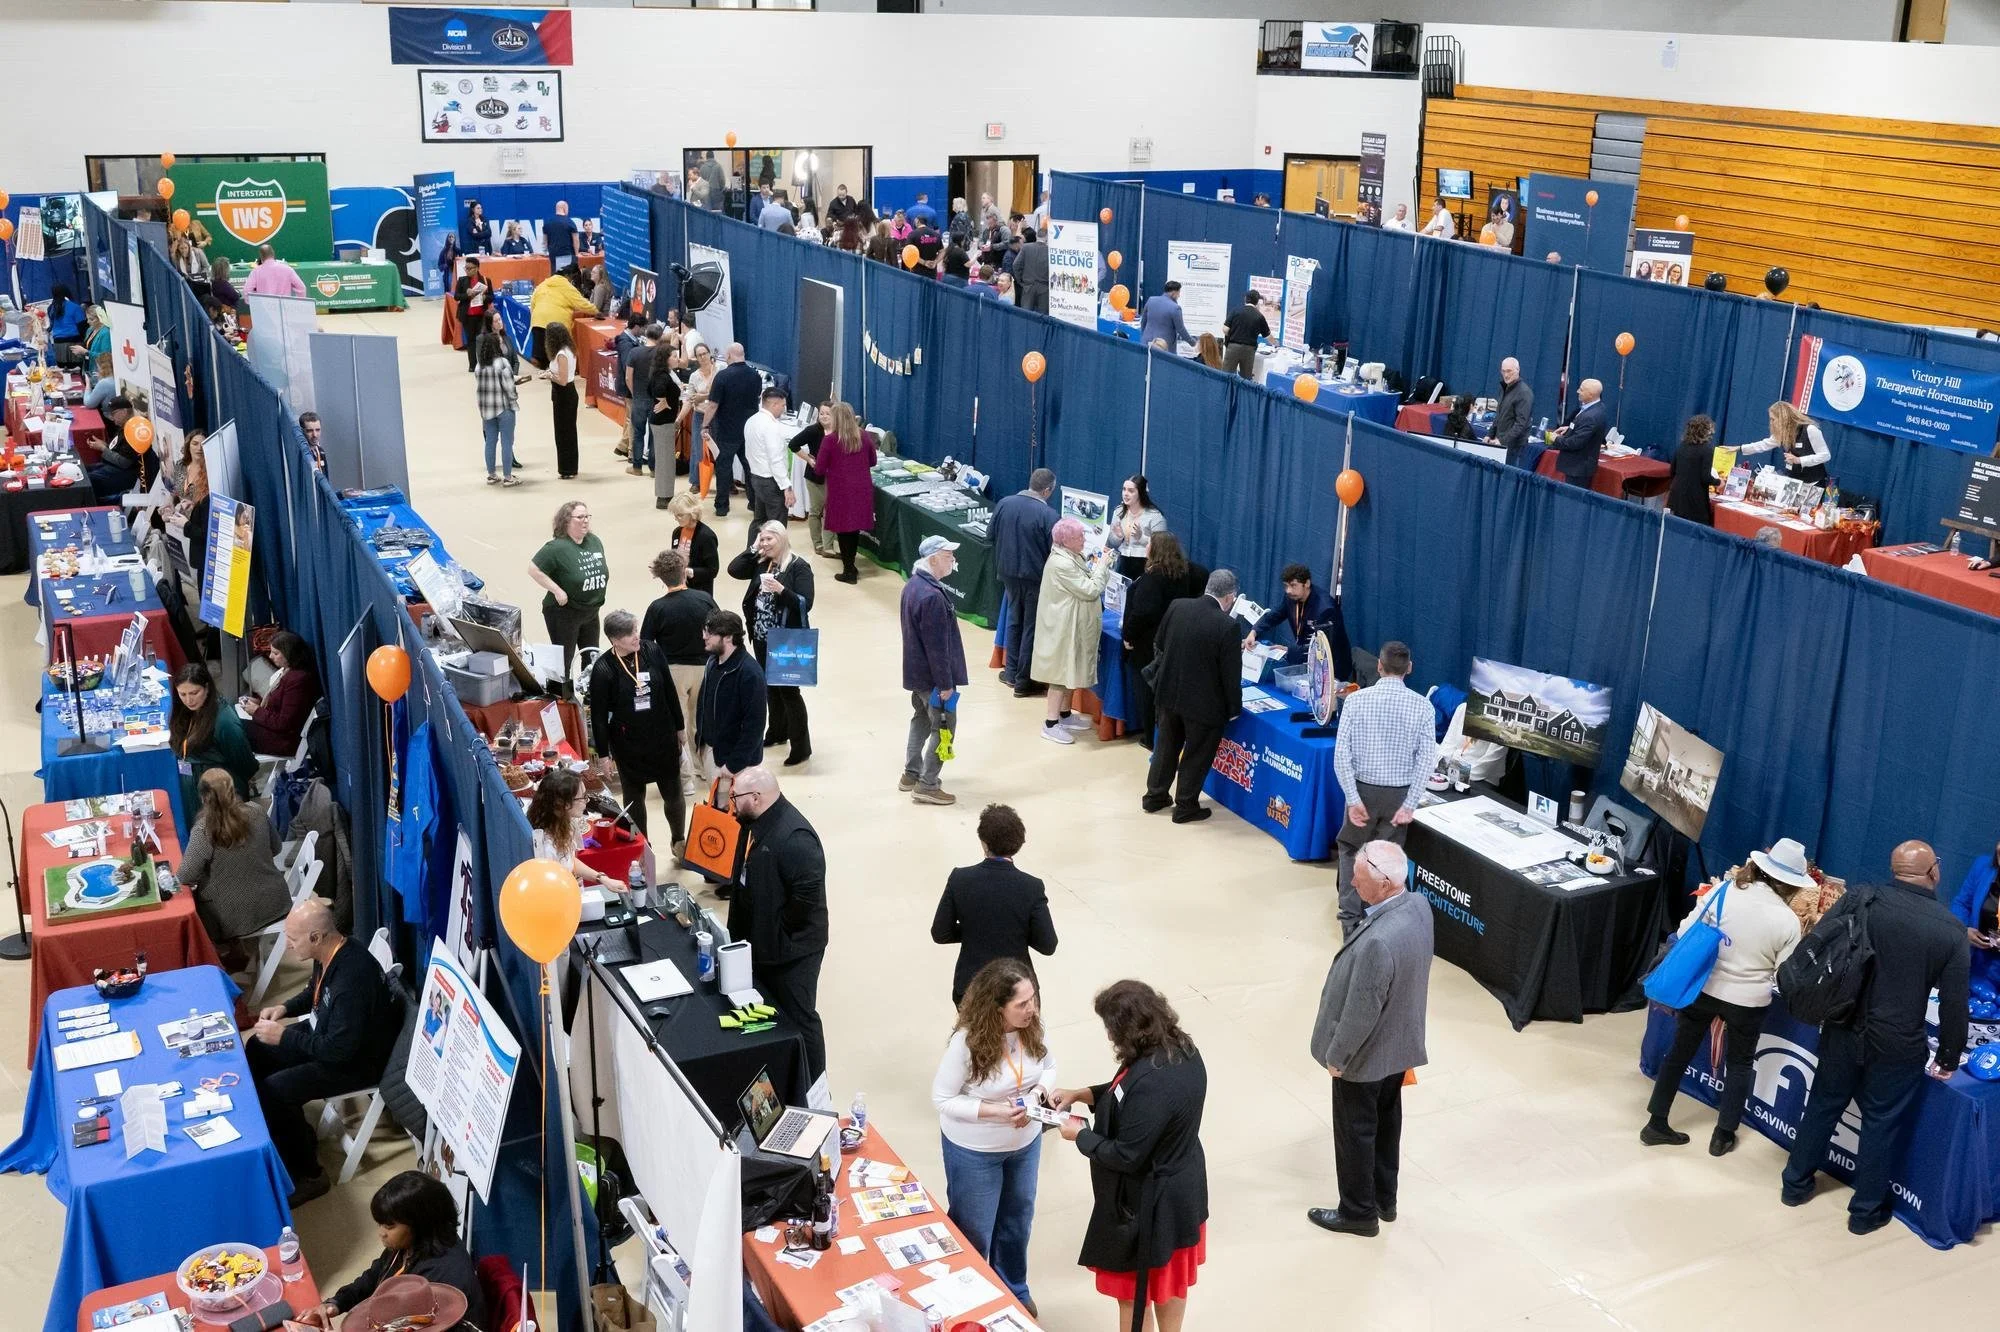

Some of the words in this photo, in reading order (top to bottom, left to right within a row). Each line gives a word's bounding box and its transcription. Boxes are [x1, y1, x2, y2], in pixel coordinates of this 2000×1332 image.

[1306, 47, 1353, 58] KNIGHTS
[227, 189, 273, 198] INTERSTATE
[232, 206, 273, 230] IWS
[1536, 206, 1555, 215] Business
[1555, 210, 1574, 218] solutions
[1050, 254, 1093, 269] BELONG
[1059, 248, 1079, 256] WHERE
[1073, 305, 1090, 313] More.
[1912, 369, 1943, 385] Victory
[1944, 376, 1961, 389] Hill
[1876, 377, 1925, 397] Therapeutic
[1927, 385, 1994, 413] Horsemanship
[1891, 398, 1907, 408] Finding
[1908, 402, 1918, 411] Hope
[1923, 404, 1939, 415] Healing
[1939, 408, 1957, 419] through
[1906, 415, 1921, 426] (845)
[1921, 416, 1951, 431] 843-0020
[582, 574, 606, 591] CATS
[1217, 746, 1247, 772] CAR
[1262, 754, 1303, 782] LAUNDROMA
[1212, 757, 1252, 790] WASH
[1417, 865, 1471, 908] FREESTONE
[1416, 884, 1485, 936] ARCHITECTURE
[1753, 1105, 1797, 1141] SAVING
